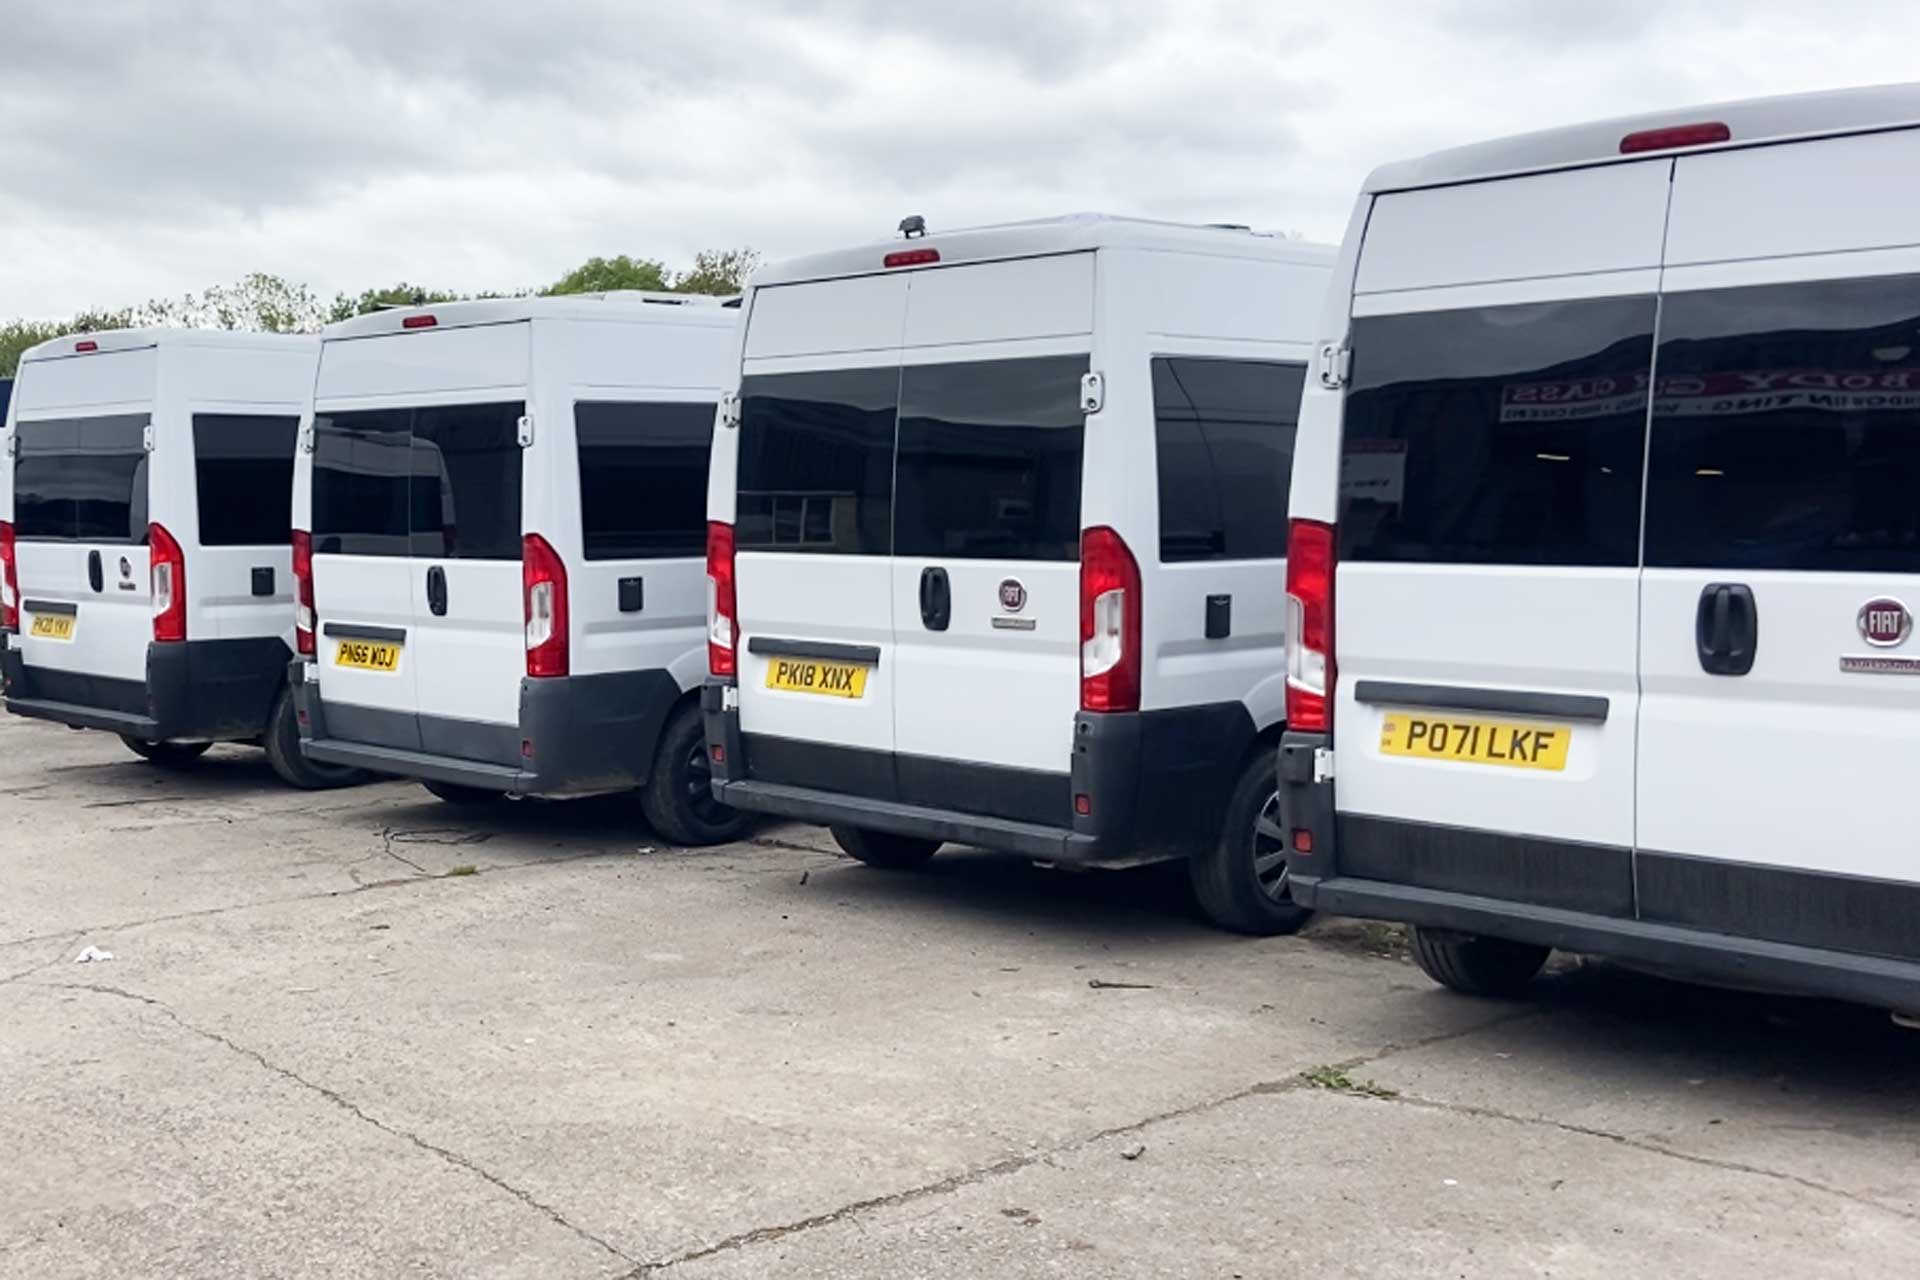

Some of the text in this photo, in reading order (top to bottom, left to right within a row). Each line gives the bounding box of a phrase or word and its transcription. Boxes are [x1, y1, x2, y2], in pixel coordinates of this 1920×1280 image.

[1869, 610, 1901, 634] FIAT
[776, 662, 856, 690] PK18 XNX
[1406, 720, 1555, 762] PO71 LKF
